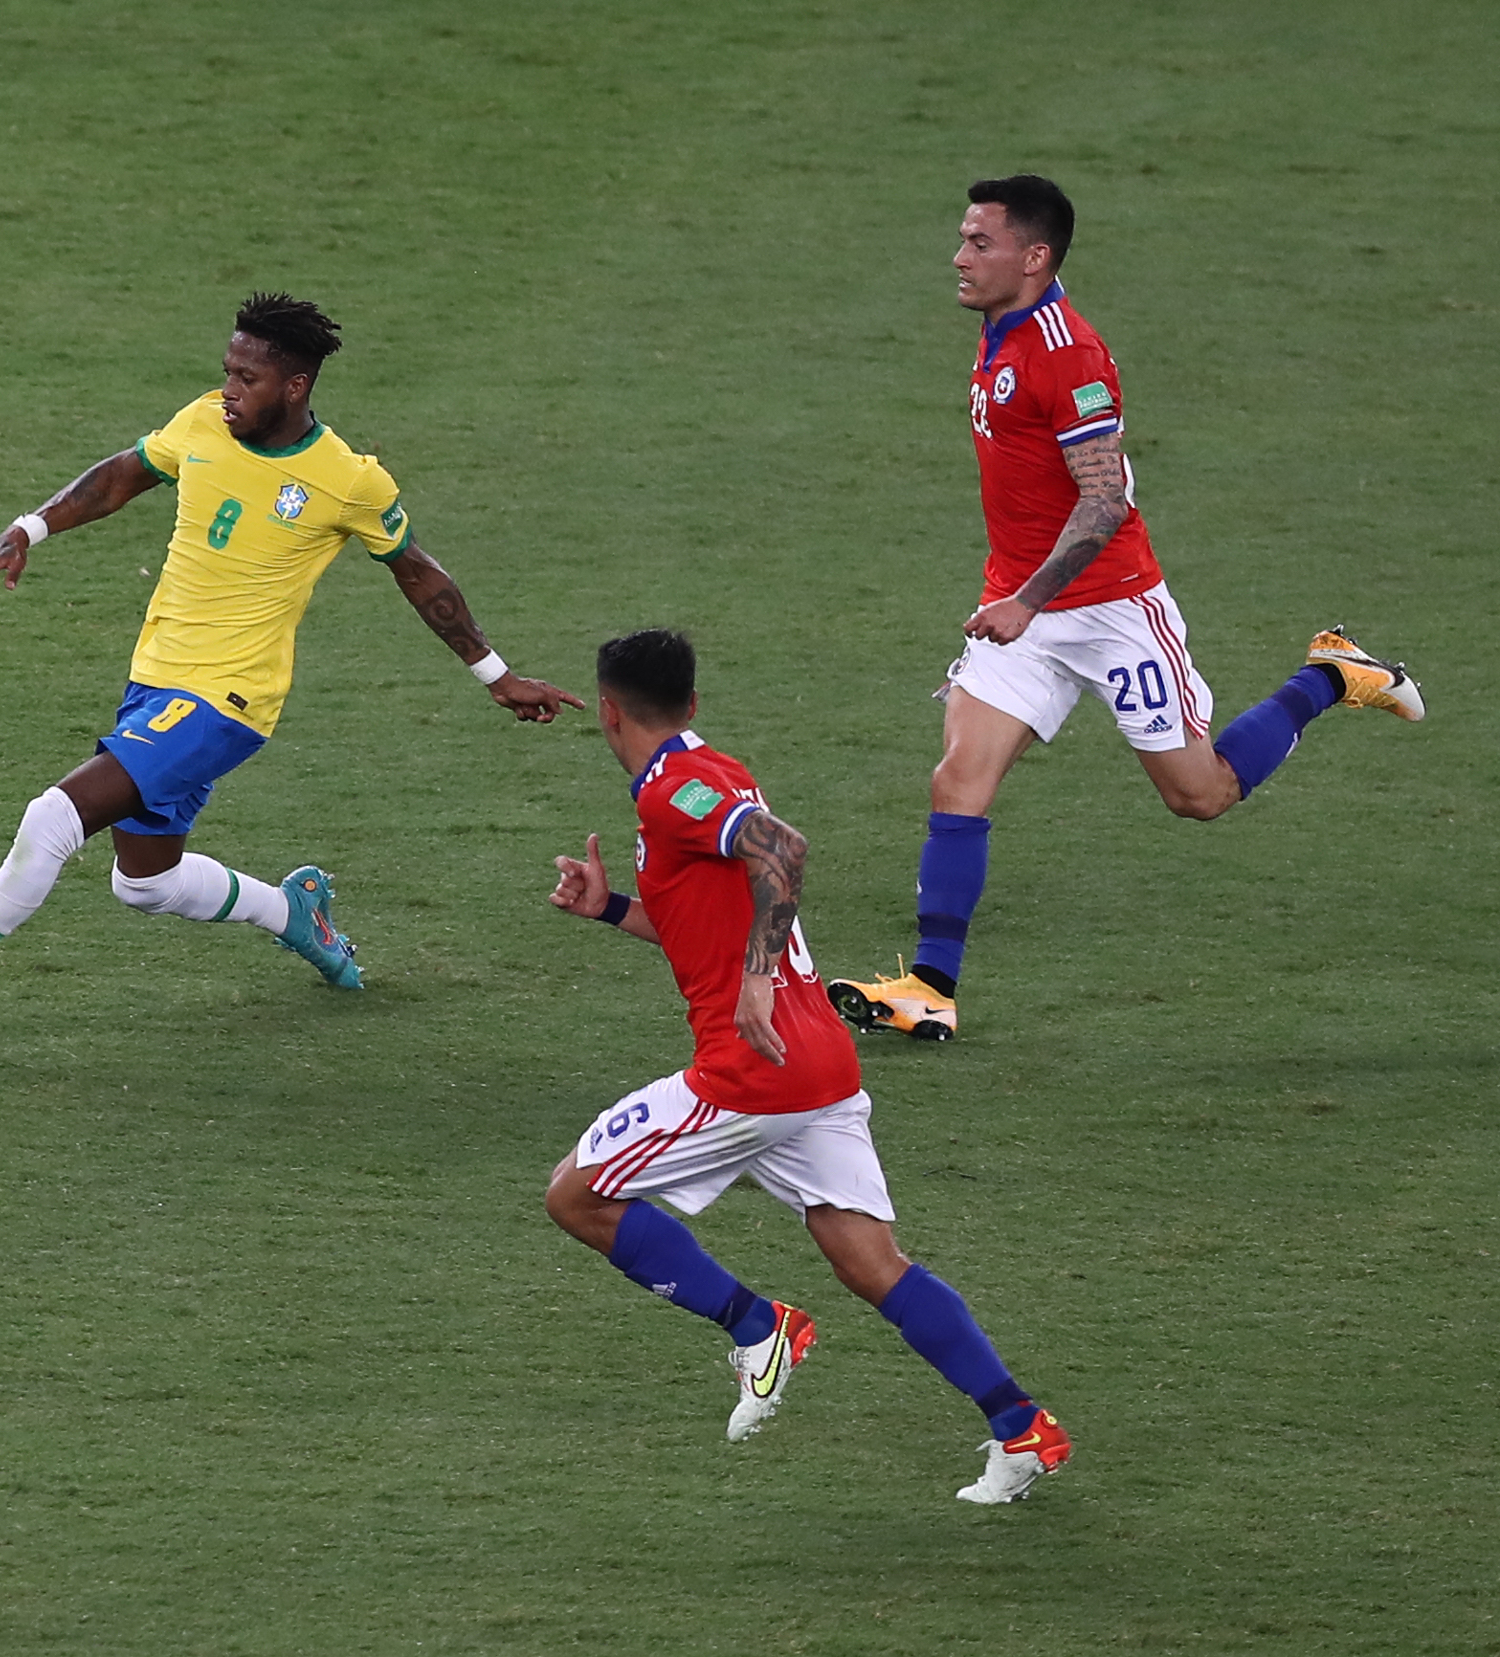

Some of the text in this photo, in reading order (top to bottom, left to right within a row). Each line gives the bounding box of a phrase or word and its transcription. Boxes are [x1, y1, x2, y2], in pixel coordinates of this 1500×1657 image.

[208, 498, 243, 551] 8
[1107, 660, 1169, 713] 20
[147, 697, 198, 733] 8
